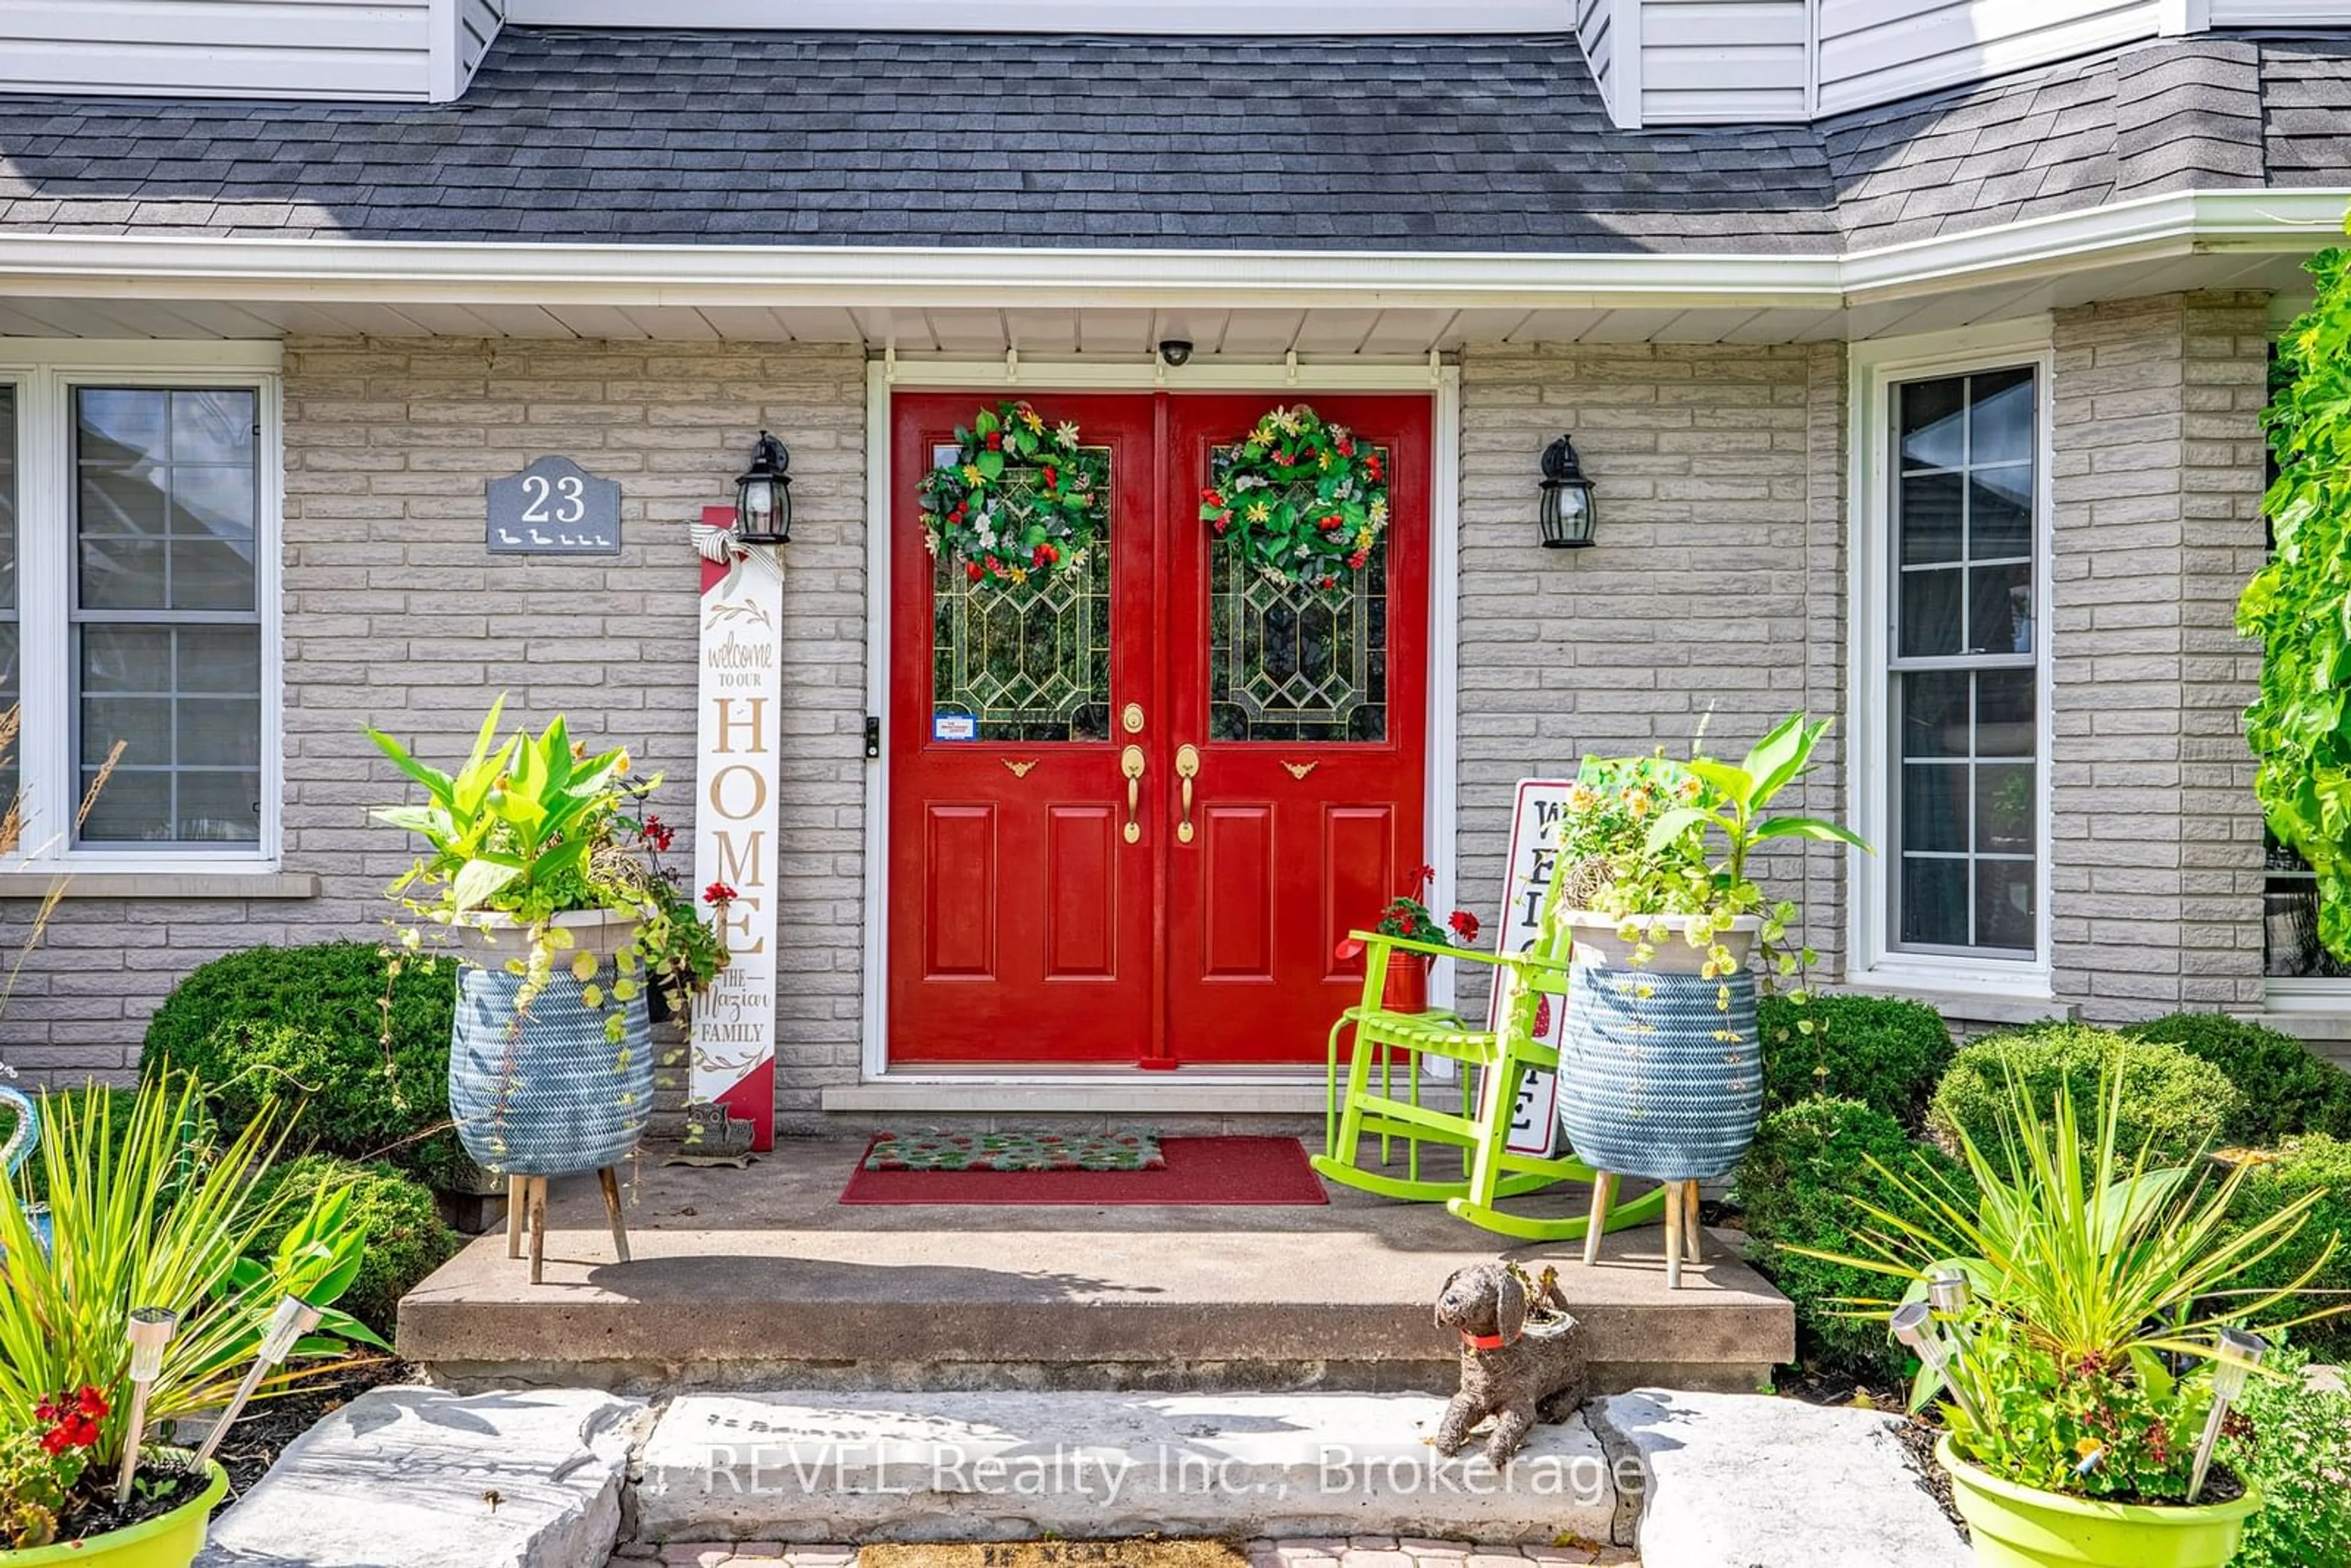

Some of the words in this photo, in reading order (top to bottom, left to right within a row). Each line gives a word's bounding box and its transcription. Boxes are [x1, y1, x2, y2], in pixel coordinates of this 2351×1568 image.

[522, 476, 584, 522] 23
[708, 631, 772, 669] welcome
[718, 673, 734, 686] TO
[737, 673, 761, 686] OUR
[710, 697, 768, 953] HOME
[723, 969, 745, 987] THE
[702, 1023, 764, 1042] FAMILY
